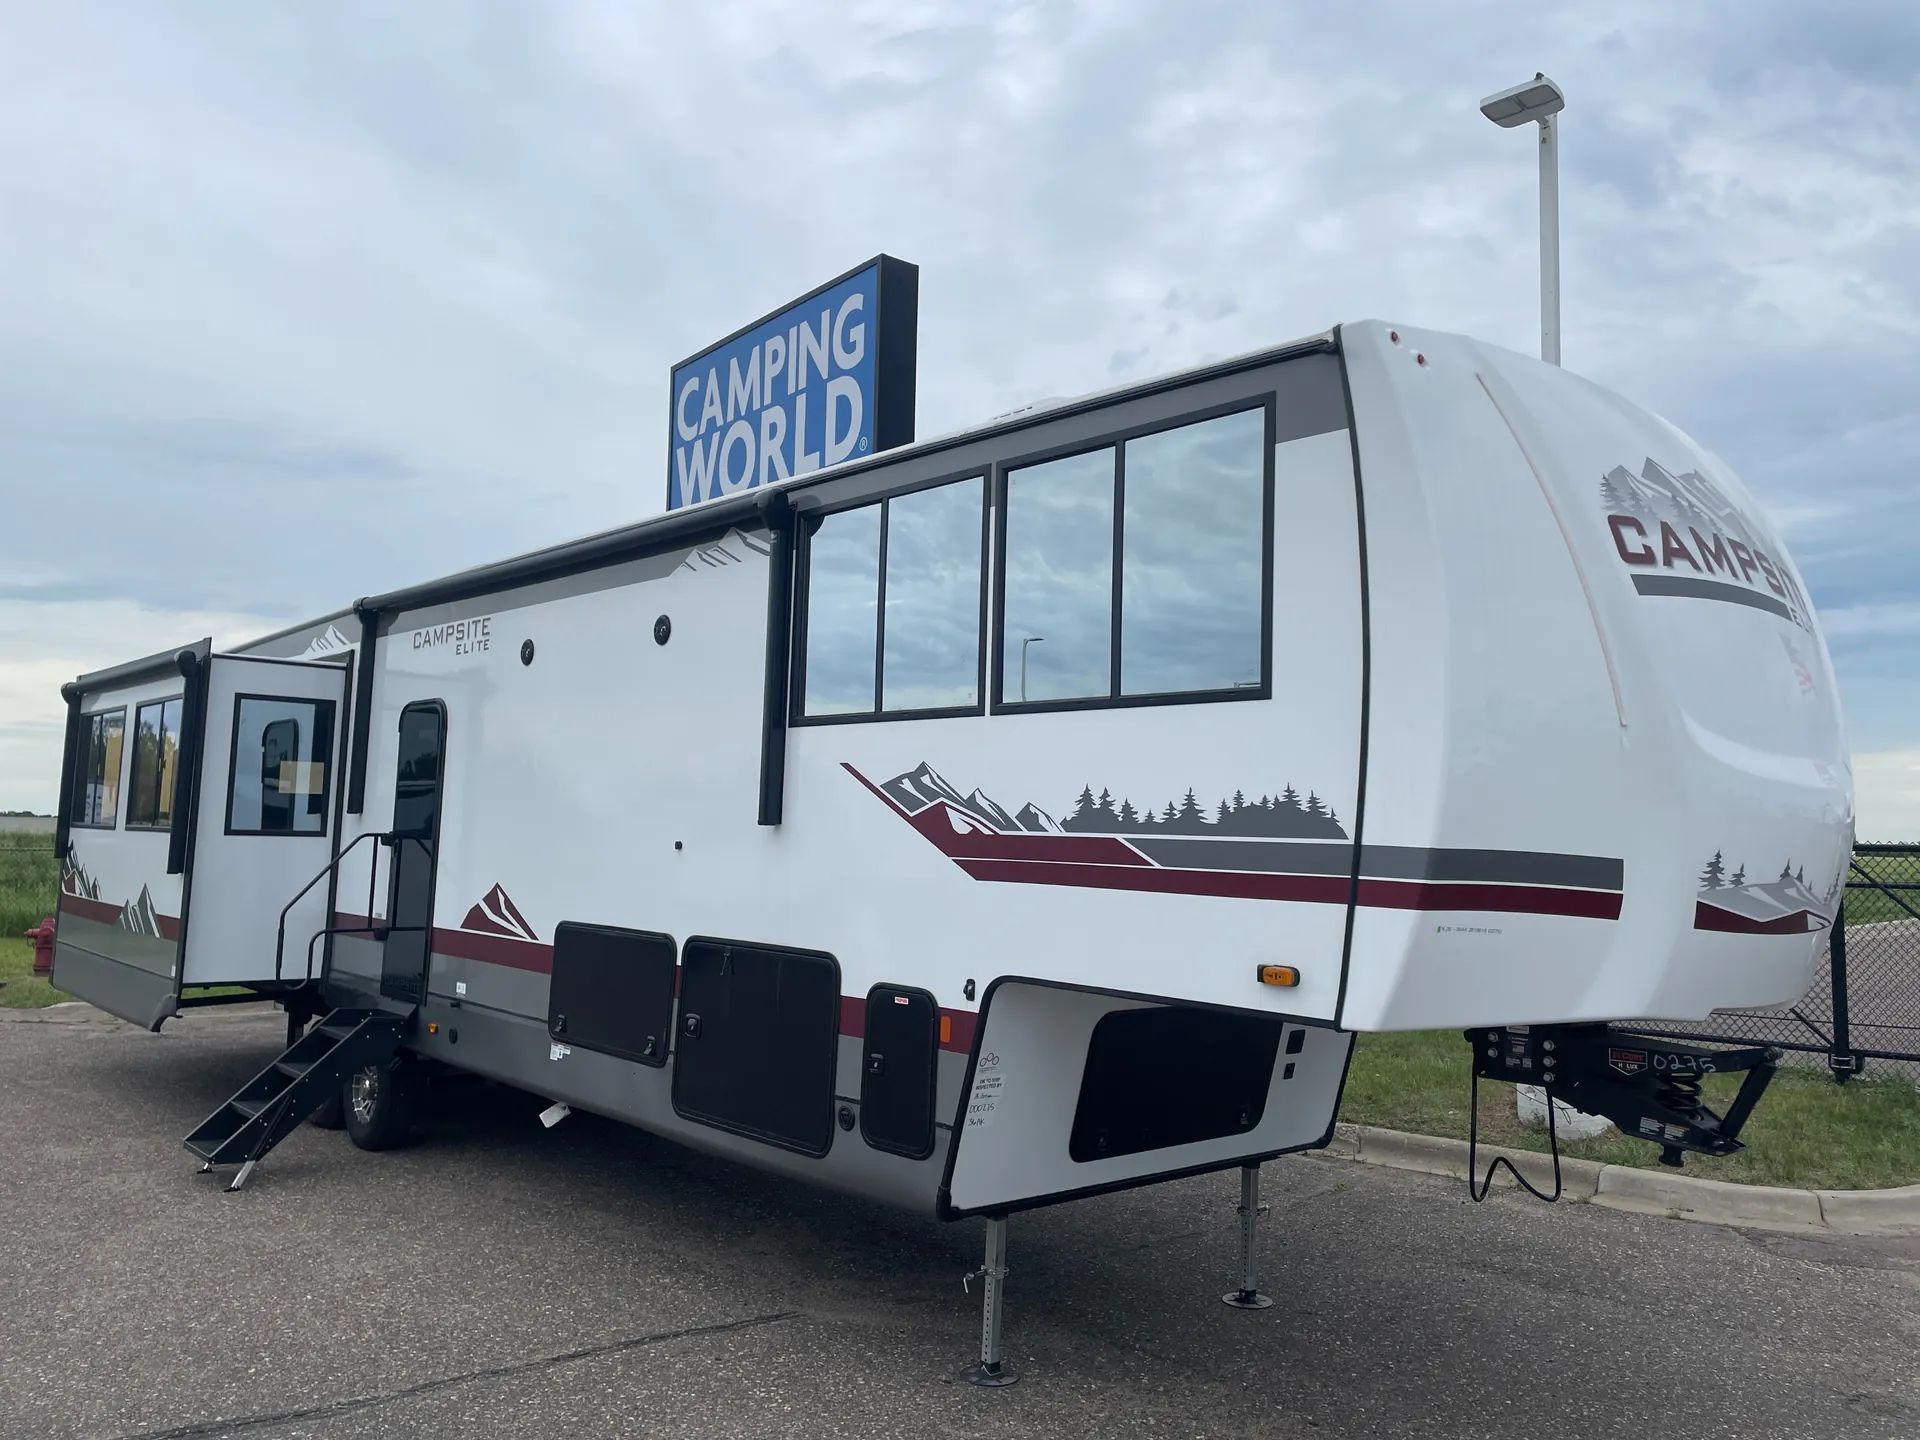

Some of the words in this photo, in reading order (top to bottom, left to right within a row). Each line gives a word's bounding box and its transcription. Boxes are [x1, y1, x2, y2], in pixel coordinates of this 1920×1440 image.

[677, 293, 865, 441] CAMPING
[676, 375, 863, 507] WORLD
[413, 617, 491, 649] CAMPSITE
[456, 638, 490, 655] ELITE
[1653, 1054, 1717, 1073] 0275
